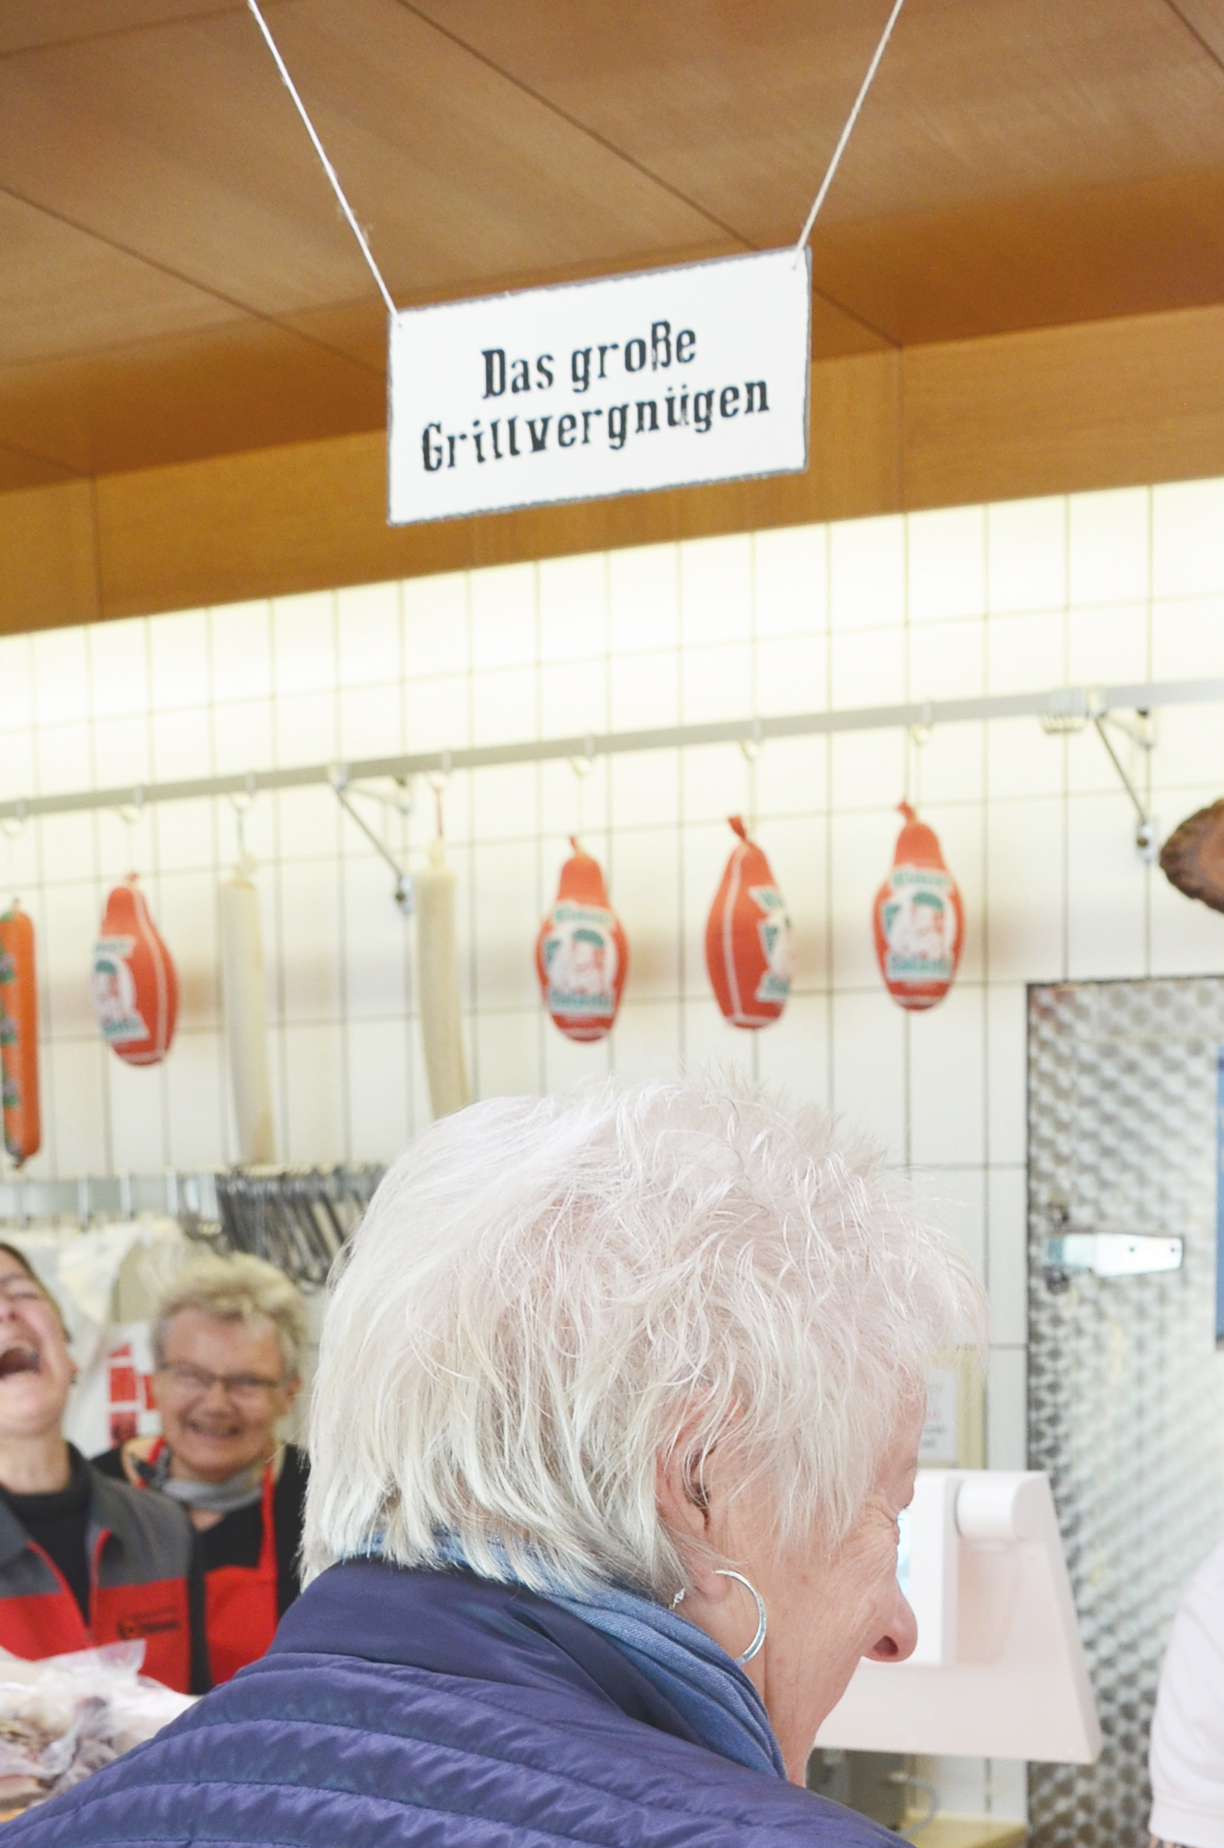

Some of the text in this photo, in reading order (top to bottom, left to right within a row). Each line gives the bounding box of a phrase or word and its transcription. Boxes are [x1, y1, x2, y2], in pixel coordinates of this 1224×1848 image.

[482, 320, 696, 399] Das große
[422, 379, 769, 472] Grillvergnügen
